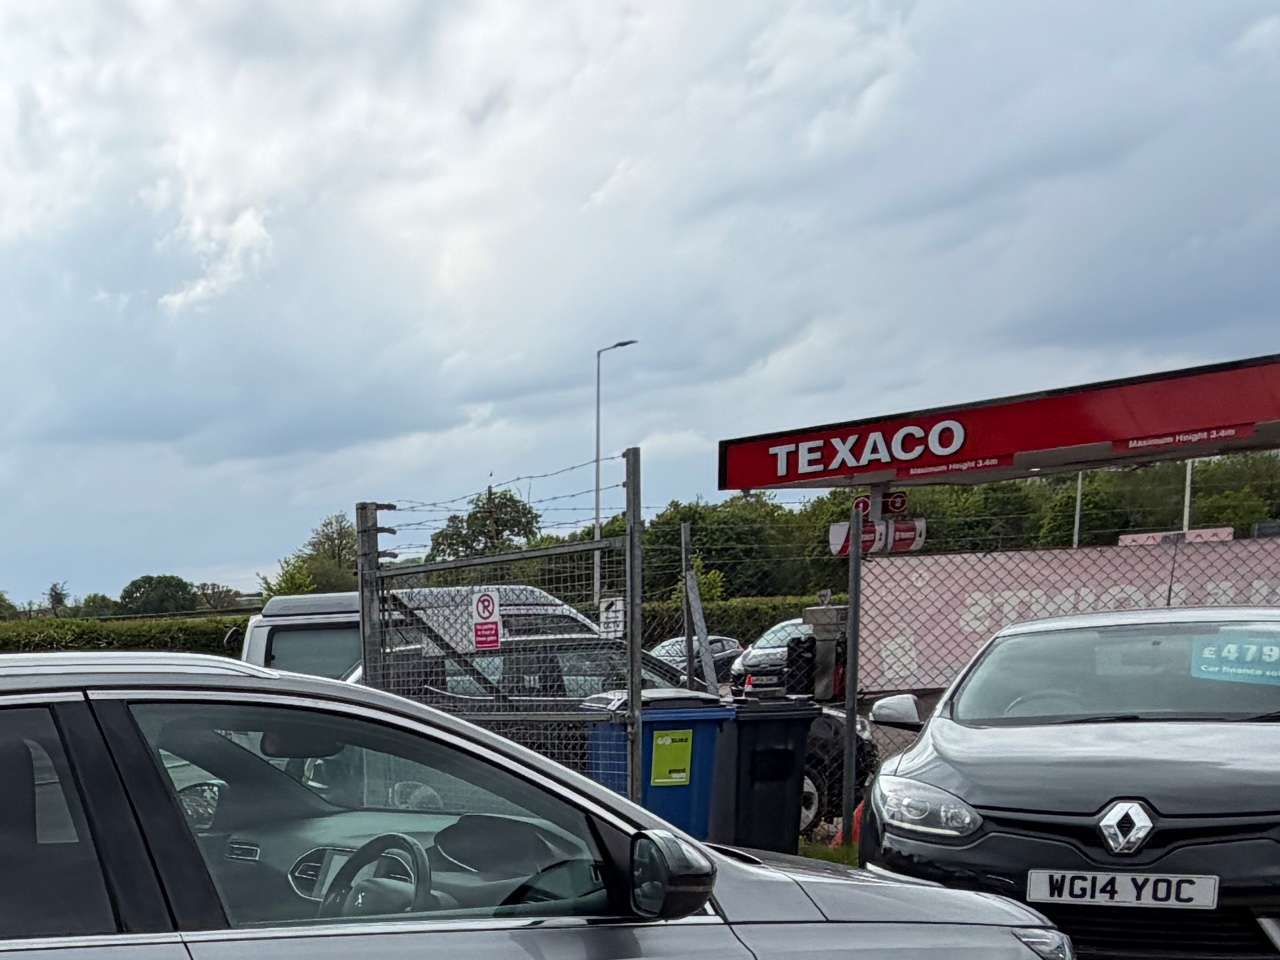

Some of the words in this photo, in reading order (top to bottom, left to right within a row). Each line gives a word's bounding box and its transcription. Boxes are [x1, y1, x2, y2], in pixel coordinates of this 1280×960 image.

[768, 419, 966, 477] TEXACO
[1175, 431, 1208, 443] Height
[1201, 643, 1280, 662] £479
[1048, 874, 1119, 901] WG14
[1130, 876, 1197, 904] YOC
